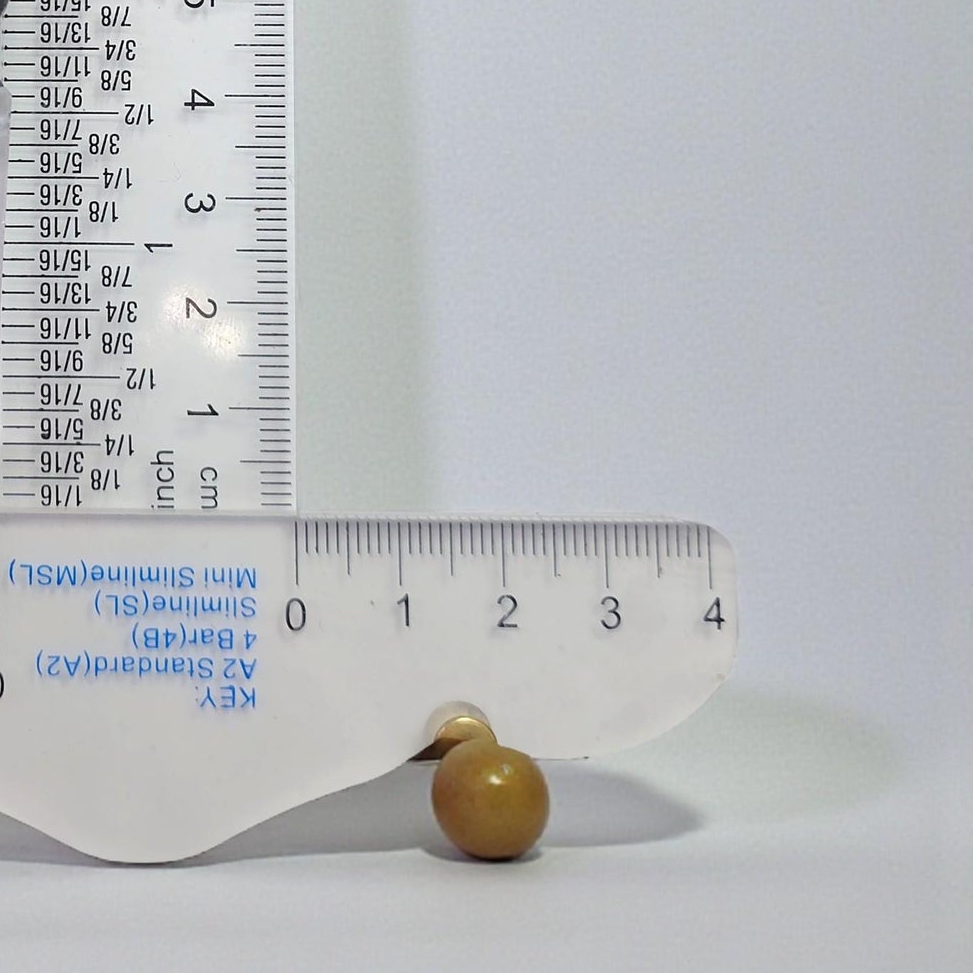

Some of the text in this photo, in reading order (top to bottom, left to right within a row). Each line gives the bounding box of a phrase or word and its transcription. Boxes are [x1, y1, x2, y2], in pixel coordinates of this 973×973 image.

[101, 6, 131, 26] 7/8
[41, 23, 91, 43] 13/16
[105, 40, 136, 60] 3/4
[41, 56, 91, 76] 11/16
[101, 70, 131, 91] 5/8
[41, 88, 82, 108] 9/16
[184, 89, 215, 110] 4
[125, 104, 154, 125] 1/2
[41, 120, 82, 140] 7/16
[89, 134, 119, 154] 3/8
[41, 153, 82, 173] 5/16
[103, 168, 132, 189] 1/4
[40, 185, 82, 206] 3/16
[184, 193, 215, 213] 3
[90, 201, 118, 222] 1/8
[40, 217, 81, 238] 1/16
[144, 244, 173, 253] 1
[40, 250, 91, 271] 15/16
[102, 266, 132, 287] 7/8
[40, 283, 91, 303] 13/16
[106, 301, 137, 323] 3/4
[186, 298, 217, 318] 2
[40, 318, 91, 339] 11/16
[102, 333, 133, 354] 5/8
[41, 350, 83, 371] 9/16
[126, 368, 155, 390] 1/2
[41, 384, 83, 405] 7/16
[90, 399, 121, 420] 3/8
[187, 404, 219, 417] 1
[41, 418, 83, 440] 5/16
[105, 434, 134, 456] 1/4
[41, 451, 84, 473] 3/16
[91, 469, 120, 490] 1/8
[151, 450, 174, 509] inch
[200, 467, 218, 509] cm
[41, 485, 82, 507] 1/16
[9, 559, 257, 589] Mini Slimline(MSL)
[95, 589, 257, 617] Slimline(SL)
[397, 594, 409, 627] 1
[497, 594, 517, 627] 2
[601, 597, 621, 629] 3
[286, 598, 306, 631] 0
[703, 598, 724, 630] 4
[132, 622, 257, 649] 4 Bar(4B)
[37, 649, 257, 679] A2 Standard(A2)
[195, 685, 256, 708] KEY:
